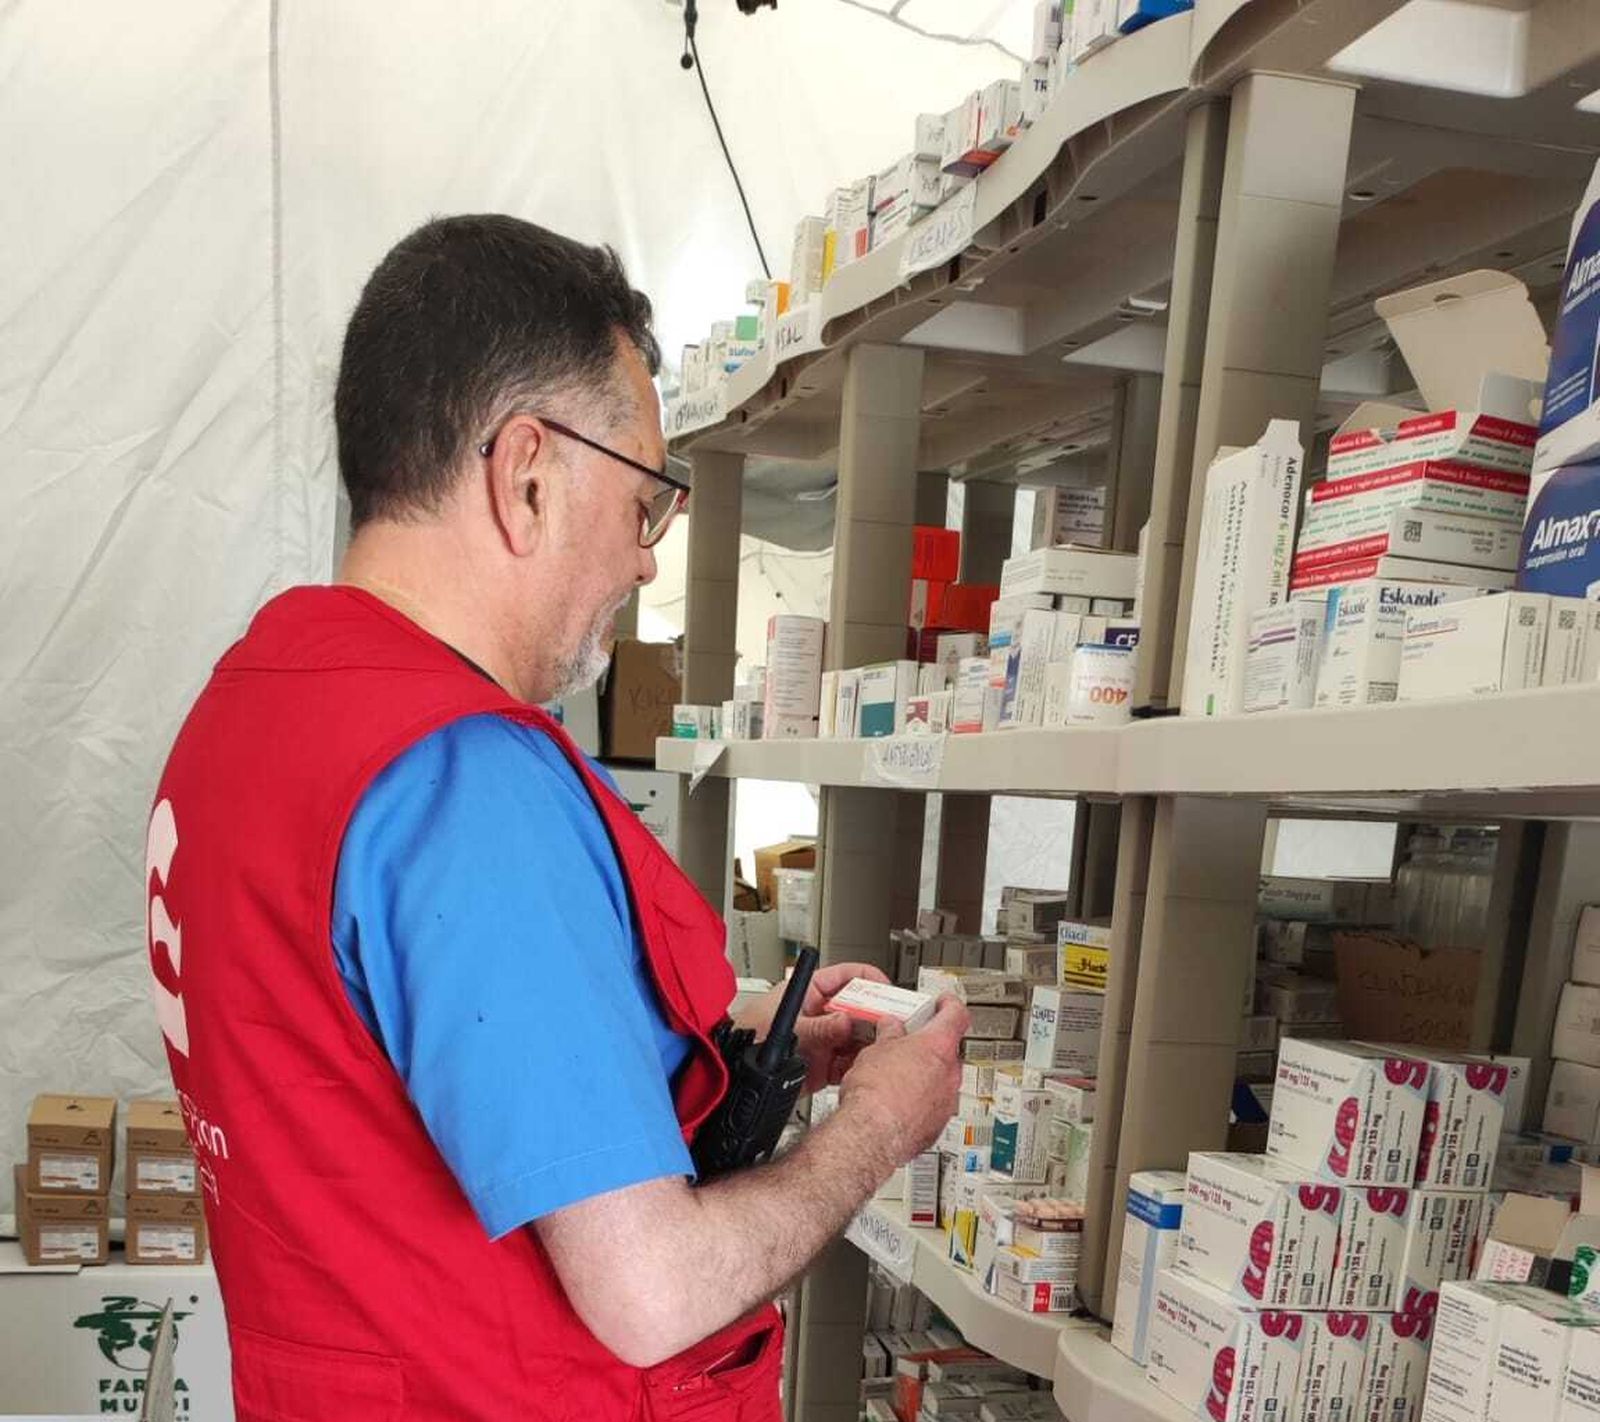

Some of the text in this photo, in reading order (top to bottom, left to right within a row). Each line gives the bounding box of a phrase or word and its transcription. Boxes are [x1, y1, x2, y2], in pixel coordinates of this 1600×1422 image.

[1278, 456, 1298, 519] Adenocor
[1530, 515, 1588, 552] Almax
[99, 1379, 189, 1393] FARA
[101, 1398, 189, 1412] MUI
